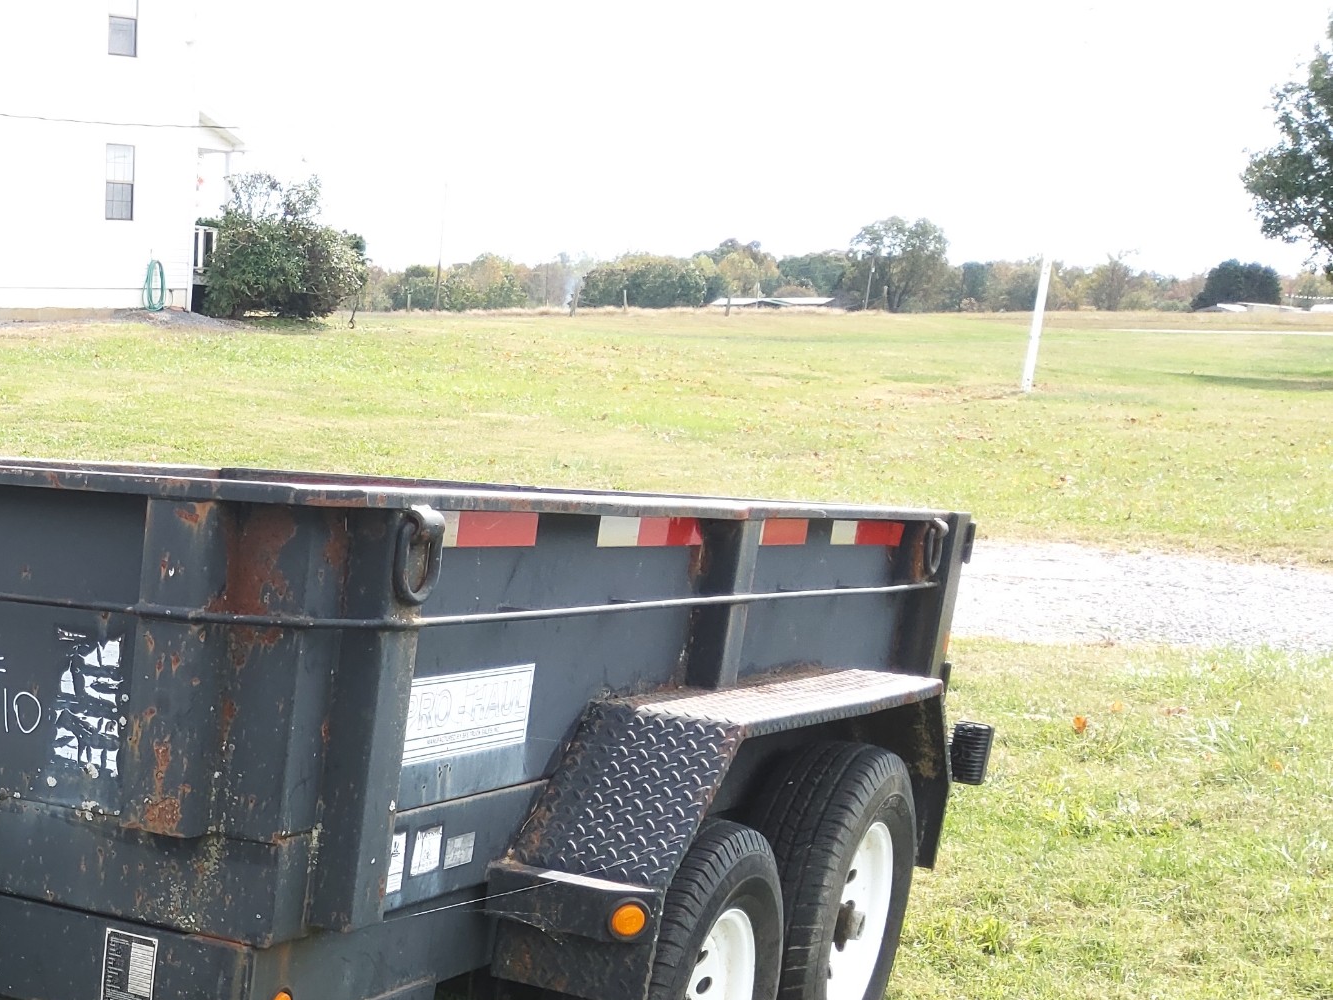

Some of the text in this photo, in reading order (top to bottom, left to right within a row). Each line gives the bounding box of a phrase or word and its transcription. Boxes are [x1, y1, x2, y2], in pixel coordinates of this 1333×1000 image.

[3, 688, 42, 734] 10
[407, 689, 453, 731] PRO
[469, 678, 527, 722] HAUL
